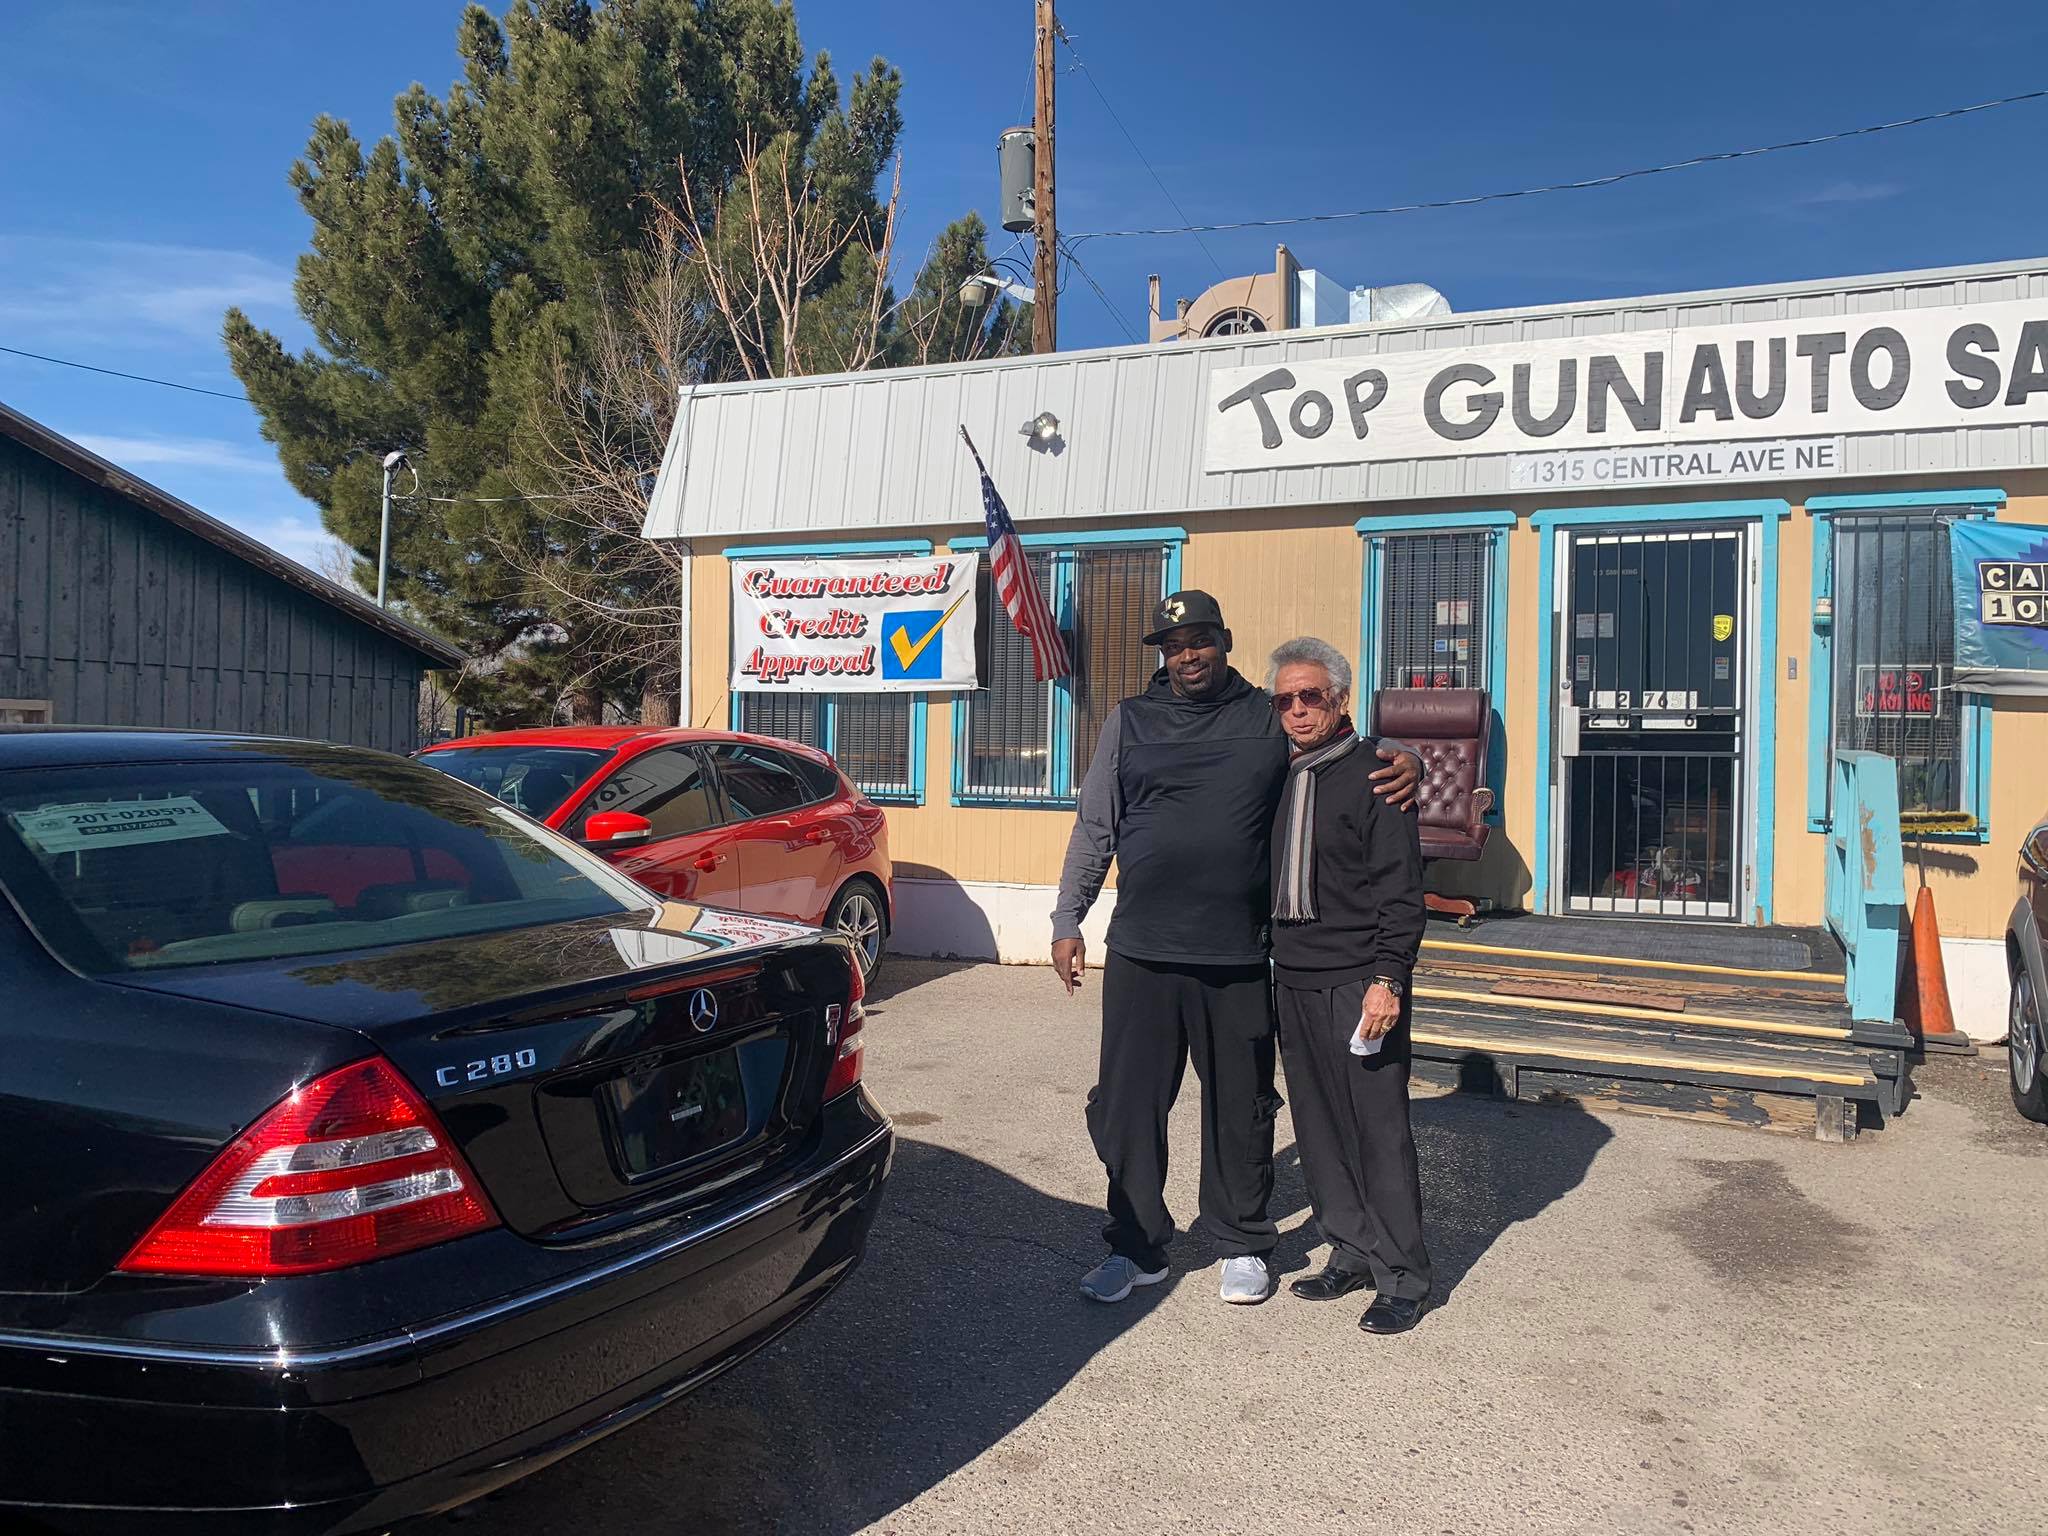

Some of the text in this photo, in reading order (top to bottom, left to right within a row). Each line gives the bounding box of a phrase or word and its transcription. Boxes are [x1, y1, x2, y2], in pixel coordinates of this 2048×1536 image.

[1423, 351, 1664, 441] GUN
[1679, 326, 1911, 423] AUTO
[1528, 444, 1835, 483] 1315 CENTRAL AVE NE
[742, 562, 954, 598] Guaranteed
[759, 608, 868, 639] Credit
[741, 643, 876, 683] Approval
[67, 806, 201, 824] 20T-020591
[436, 1048, 534, 1087] C 280
